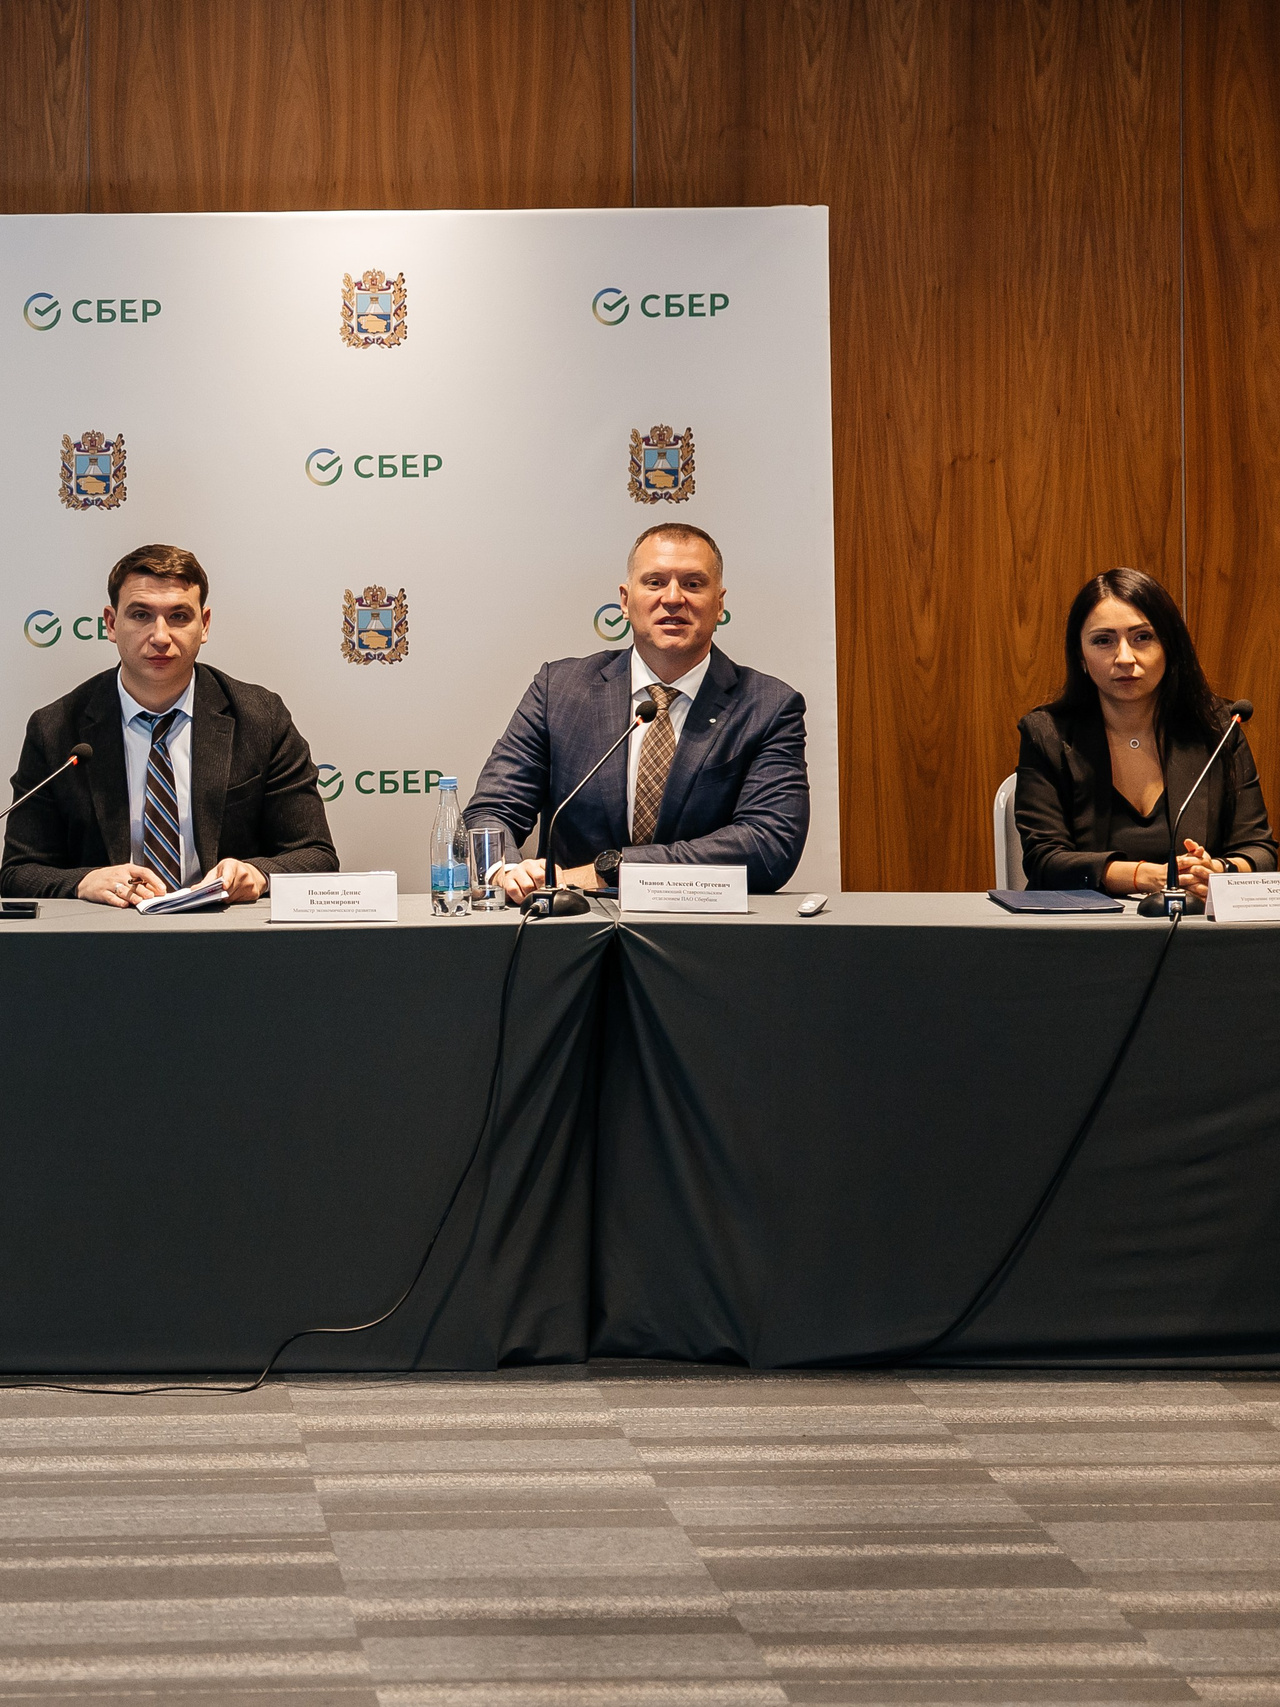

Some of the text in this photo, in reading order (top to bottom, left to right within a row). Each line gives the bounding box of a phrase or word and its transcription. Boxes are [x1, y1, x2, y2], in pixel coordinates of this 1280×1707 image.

[73, 300, 161, 323] СБЕР
[641, 294, 729, 317] СБЕР
[355, 456, 443, 479] СБЕР
[355, 770, 443, 794] СБЕР
[340, 889, 362, 897] Денис
